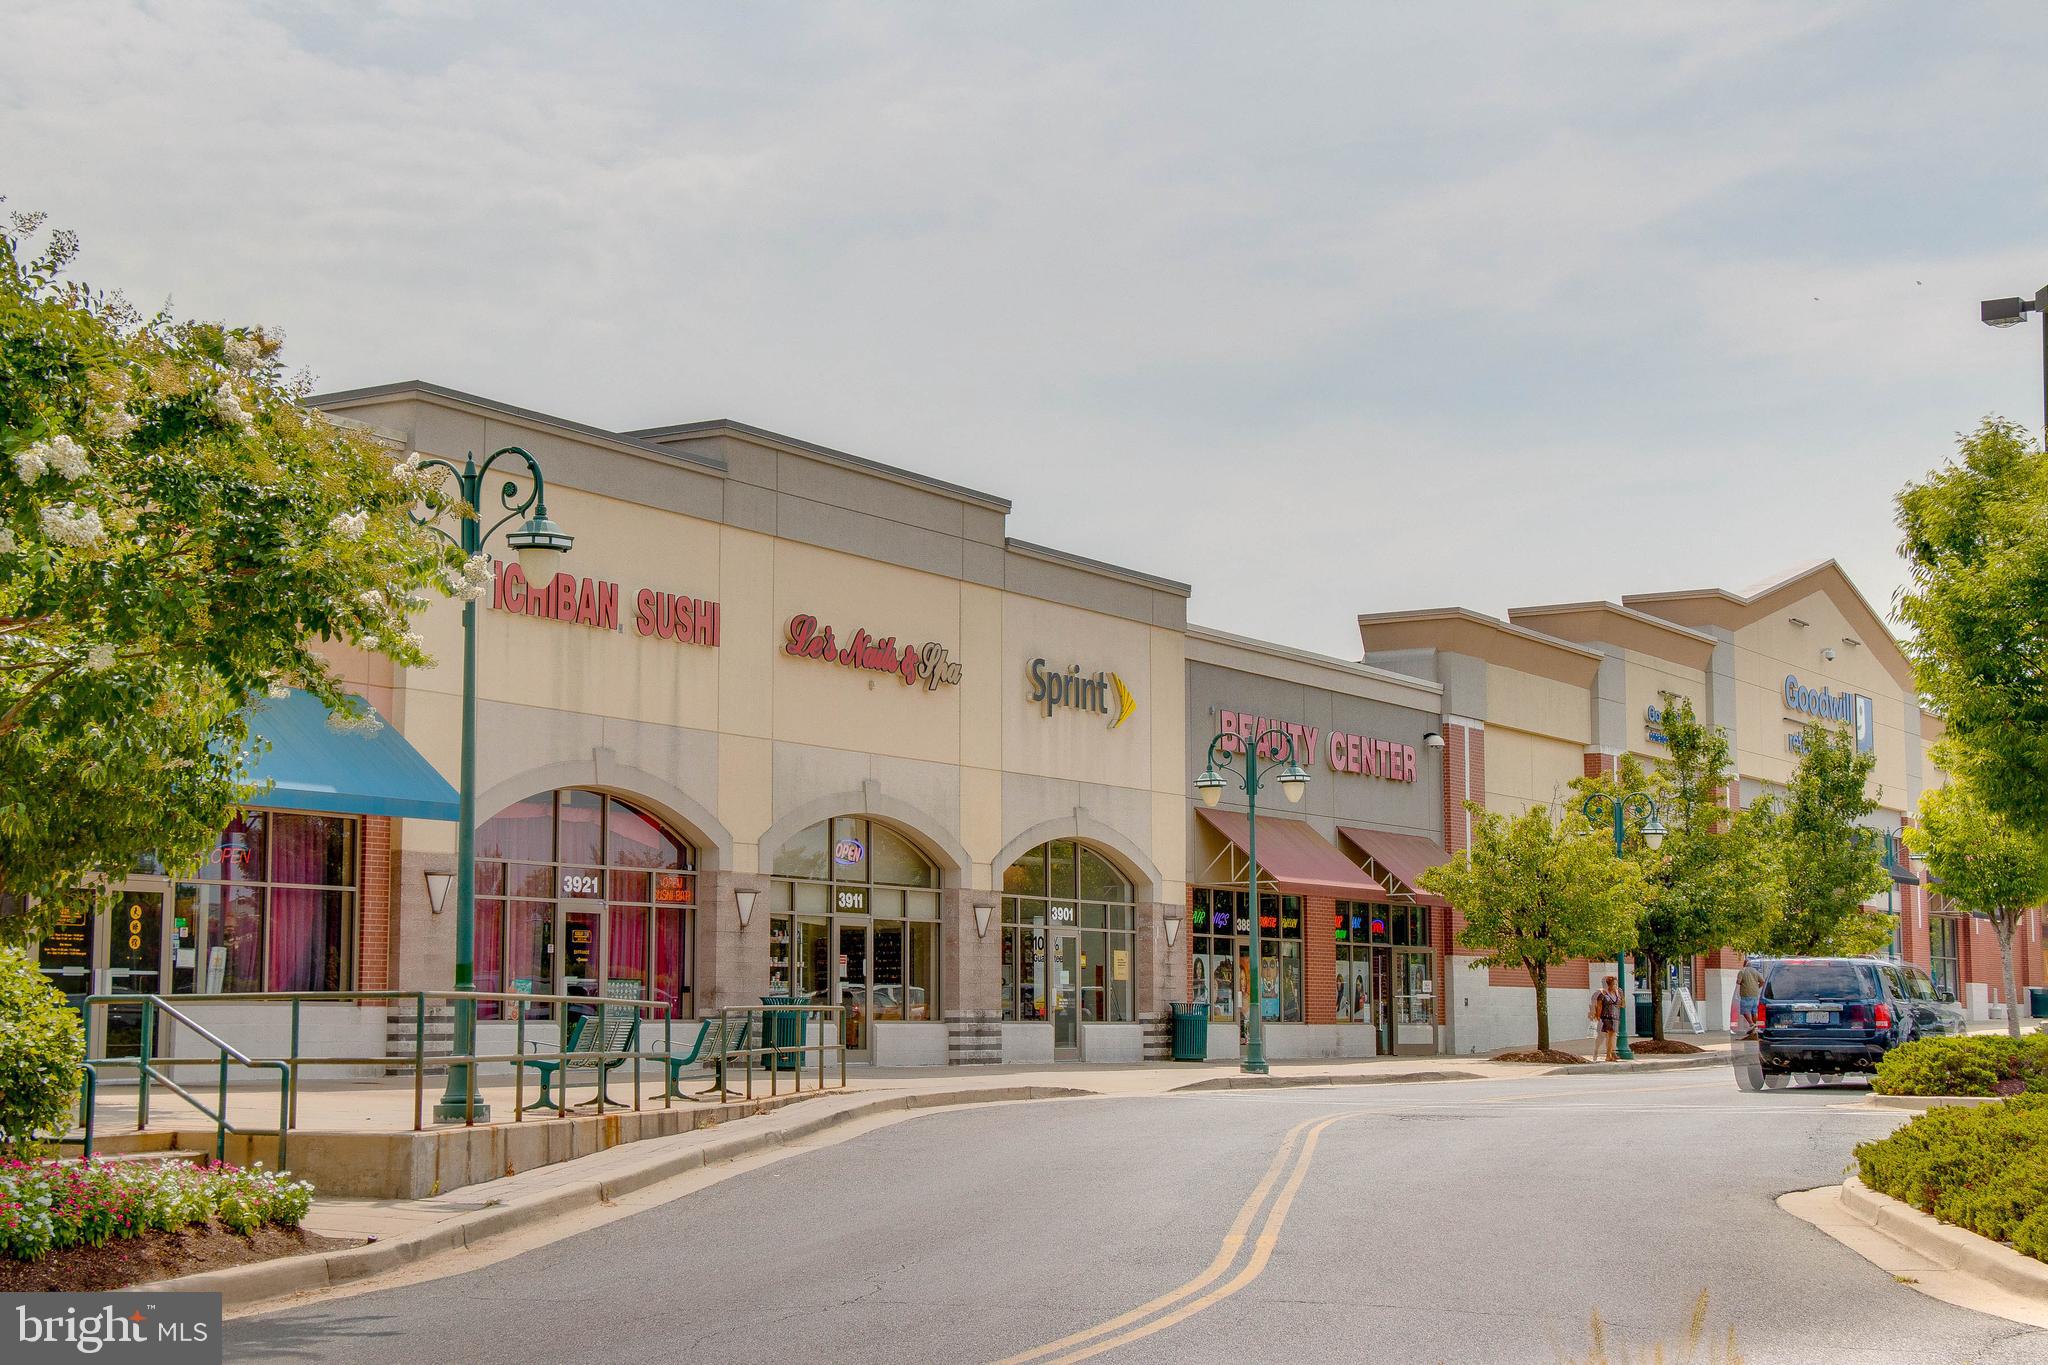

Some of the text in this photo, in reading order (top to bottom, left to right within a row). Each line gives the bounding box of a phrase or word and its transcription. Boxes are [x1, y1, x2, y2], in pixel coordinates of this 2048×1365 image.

[492, 560, 720, 648] ICHIBAN SUSHI
[839, 628, 900, 673] Nails
[900, 645, 919, 686] &
[918, 642, 962, 690] Spa
[1028, 658, 1108, 718] Sprint
[1785, 674, 1853, 725] Goodwill
[1219, 709, 1418, 784] BEAUTY CENTER
[210, 847, 252, 865] OPEN
[836, 842, 861, 863] OPEN
[563, 875, 599, 894] 3921
[838, 892, 863, 909] 3911
[1051, 906, 1074, 922] 3901
[1192, 910, 1206, 925] AIR
[1236, 918, 1251, 932] 388
